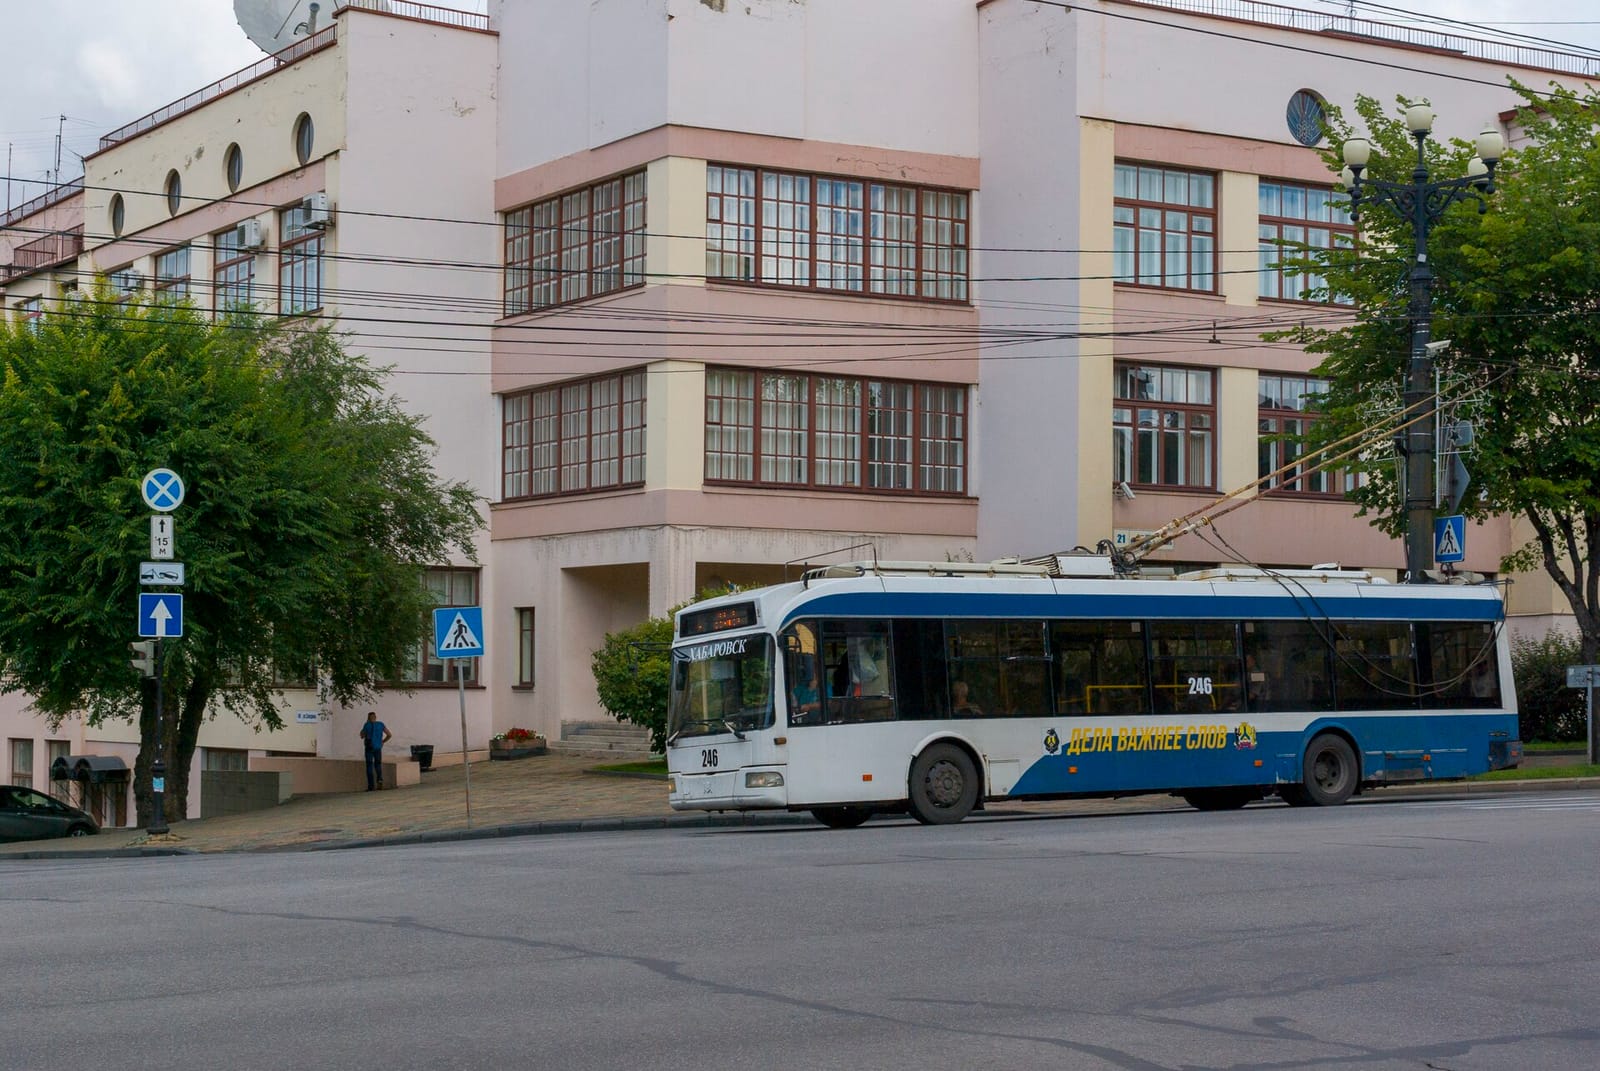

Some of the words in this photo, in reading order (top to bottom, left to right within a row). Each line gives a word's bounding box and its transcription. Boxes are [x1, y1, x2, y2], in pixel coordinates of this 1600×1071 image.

[156, 537, 168, 546] 15
[1117, 534, 1126, 543] 21
[690, 639, 747, 661] ХАБАРОВСК
[1188, 677, 1212, 694] 246
[1067, 727, 1113, 756] ДЕЛА
[1116, 725, 1184, 752] ВАЖНЕЕ
[1186, 724, 1228, 750] СЛОВ
[702, 749, 718, 767] 246
